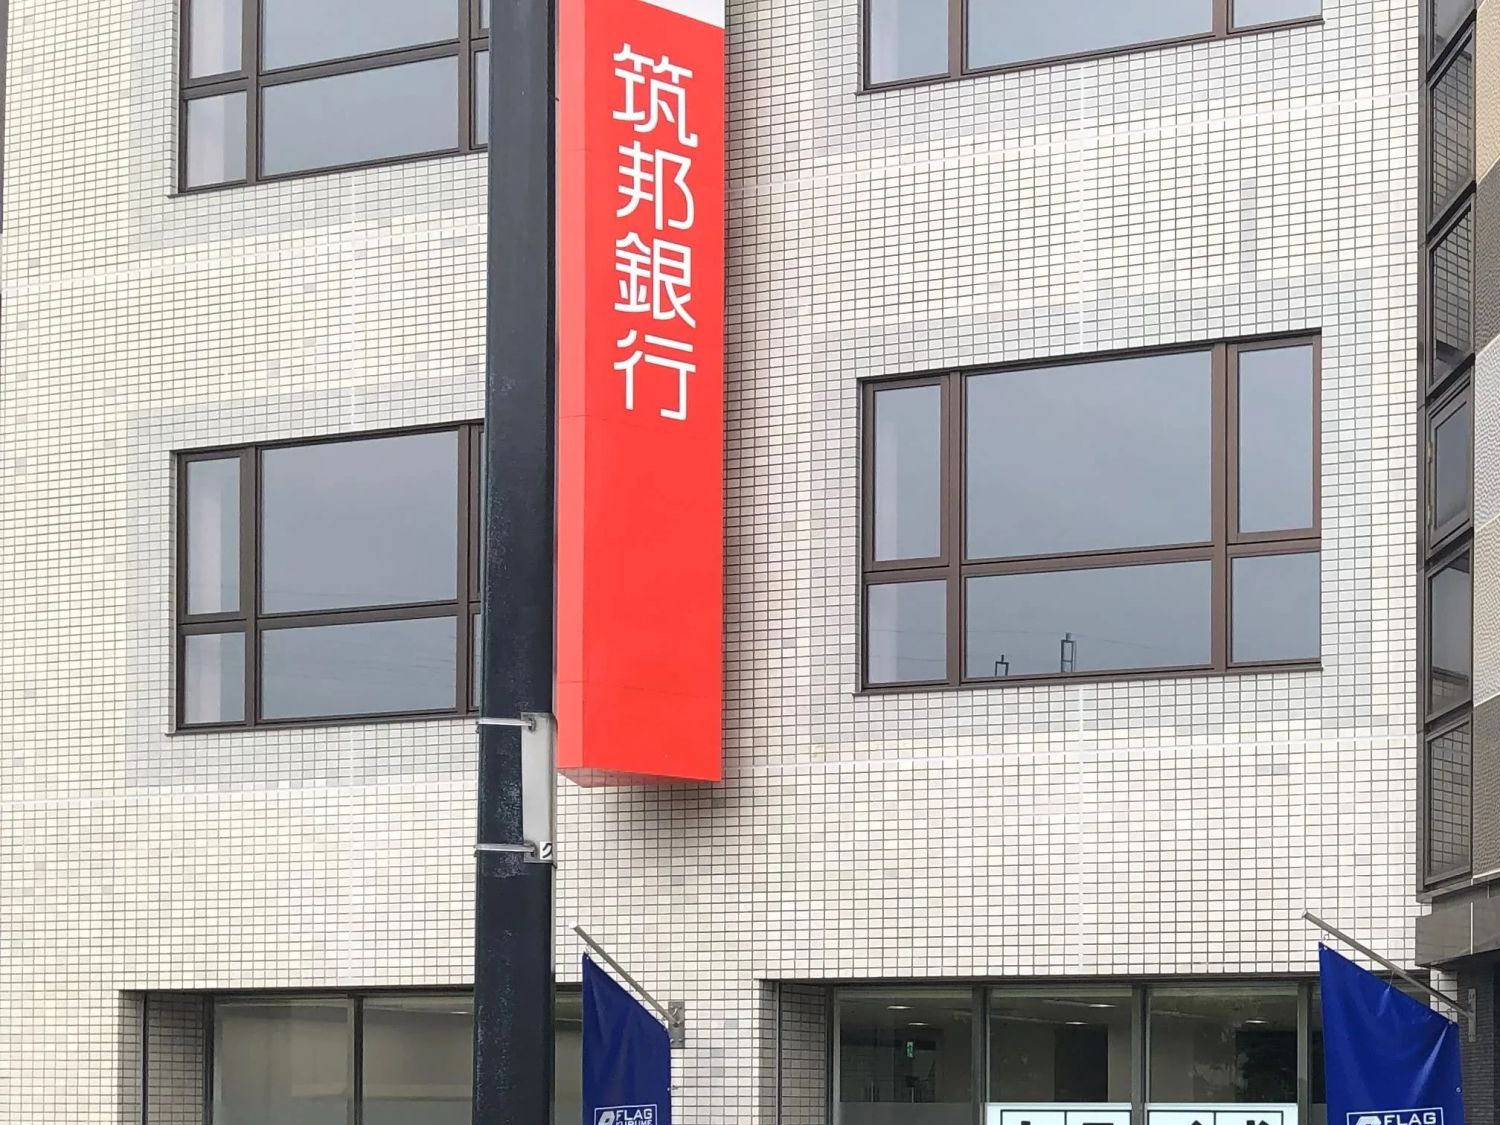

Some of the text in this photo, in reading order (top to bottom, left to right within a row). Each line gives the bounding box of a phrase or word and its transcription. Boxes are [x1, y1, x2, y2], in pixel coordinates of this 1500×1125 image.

[612, 43, 698, 421] 筑邦銀行
[616, 1108, 653, 1121] FLAG
